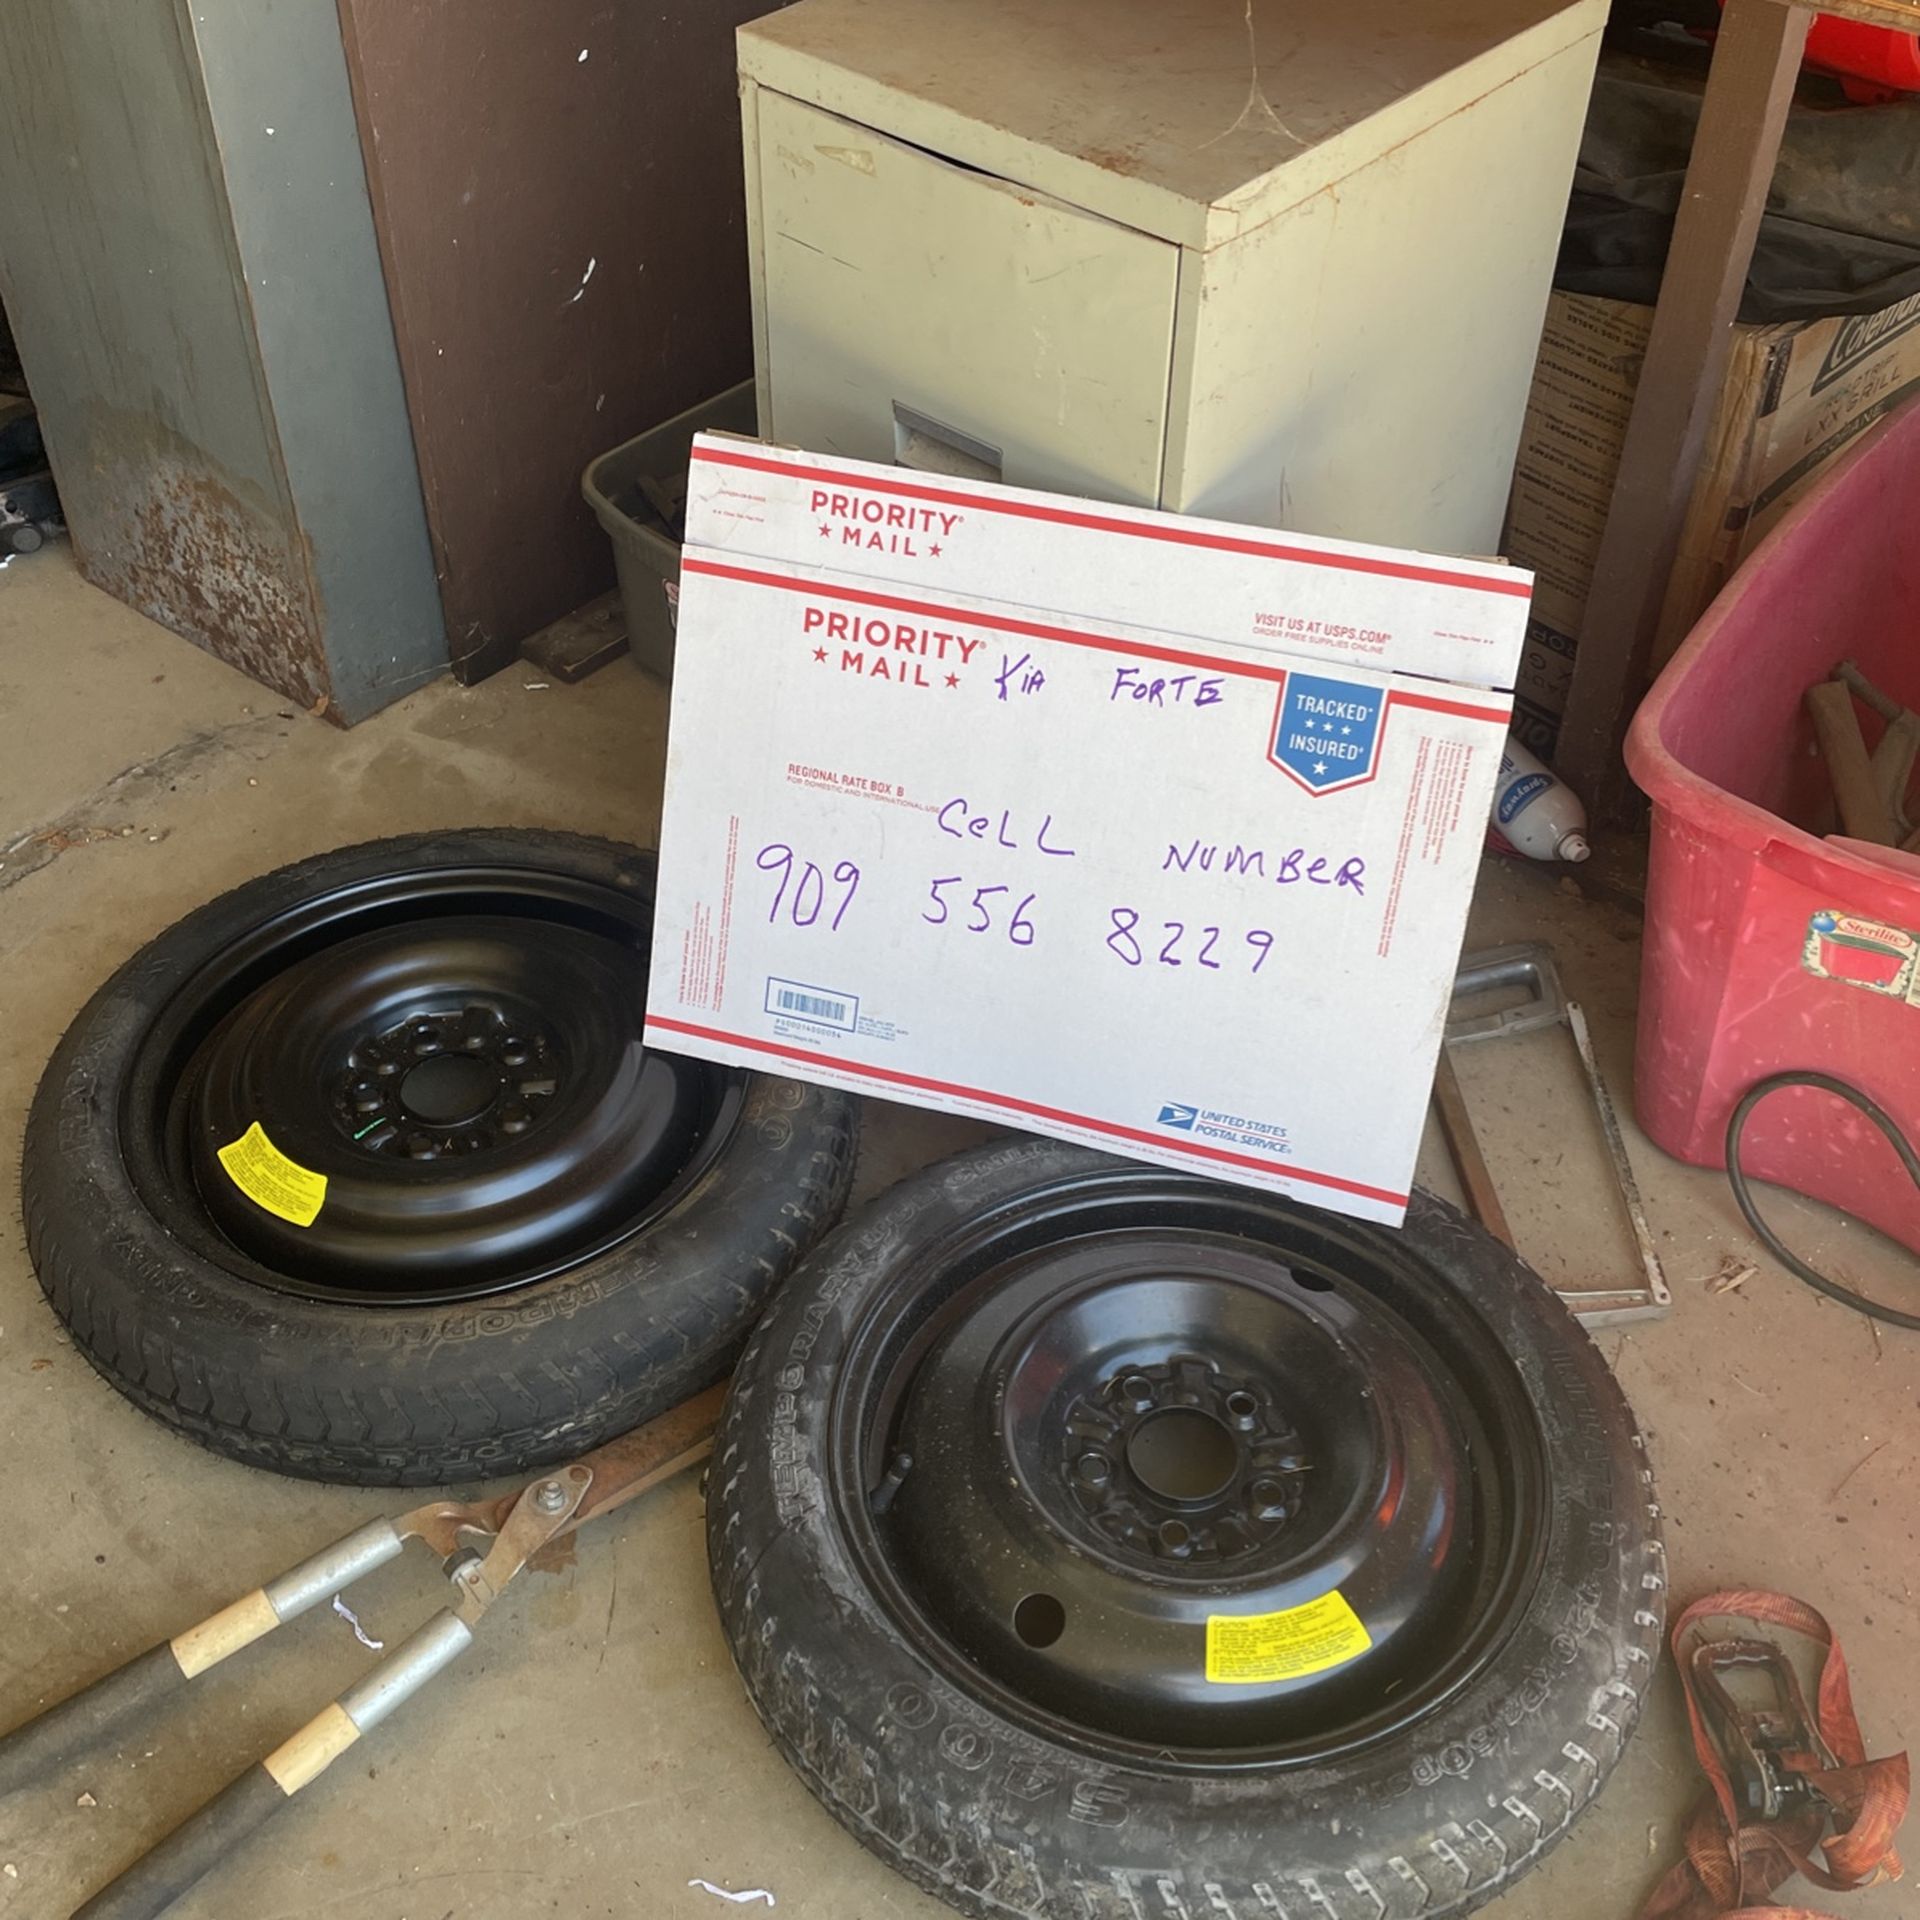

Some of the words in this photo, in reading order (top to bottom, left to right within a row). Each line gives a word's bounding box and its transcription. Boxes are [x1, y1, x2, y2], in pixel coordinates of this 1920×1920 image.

[842, 525, 917, 557] MAIL
[1254, 612, 1285, 630] VISIT
[1288, 617, 1304, 632] US
[1306, 620, 1322, 635] AT
[841, 650, 930, 687] MAIL
[788, 763, 838, 784] REGIONAL
[842, 774, 868, 791] RATE
[870, 780, 892, 795] BOX
[896, 786, 905, 797] B
[757, 844, 860, 931] 909
[921, 876, 1036, 945] 556
[1106, 908, 1275, 973] 8229
[1195, 1124, 1238, 1143] POSTAL
[1200, 1110, 1246, 1128] UNITED
[1246, 1120, 1288, 1137] STATES
